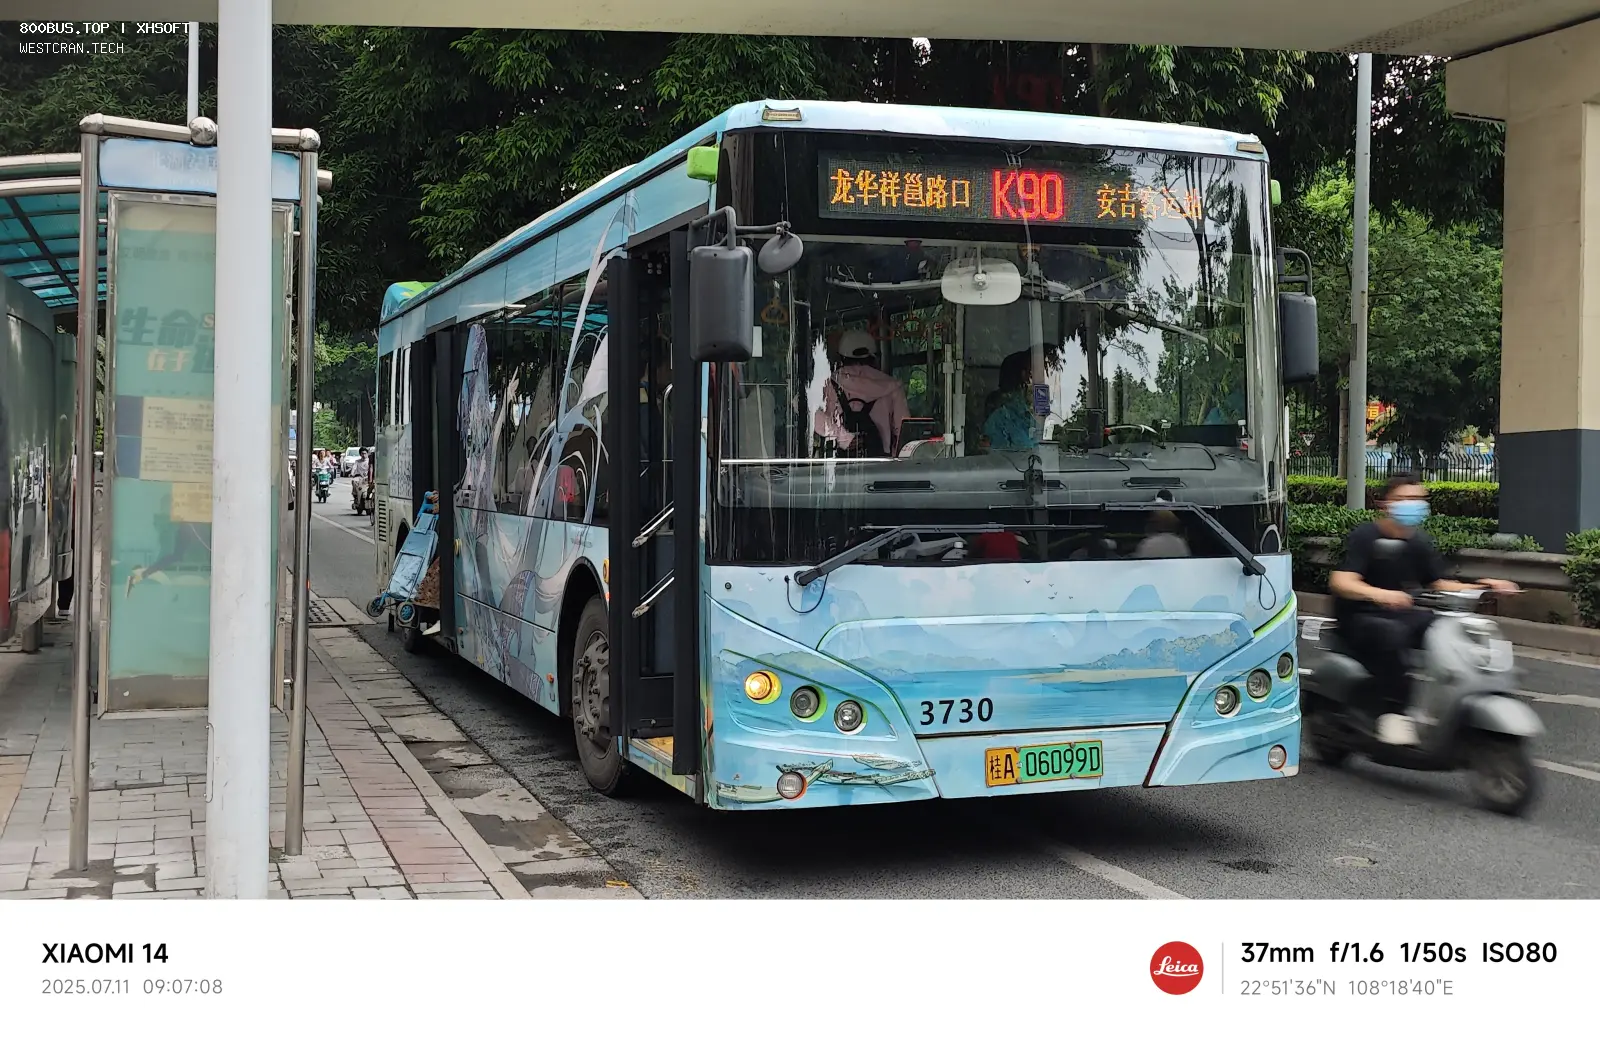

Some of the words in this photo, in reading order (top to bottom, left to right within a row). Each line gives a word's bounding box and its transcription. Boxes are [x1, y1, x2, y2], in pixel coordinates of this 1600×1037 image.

[830, 168, 970, 209] 龙华祥邕路口
[992, 170, 1064, 220] K90
[920, 697, 994, 726] 3730
